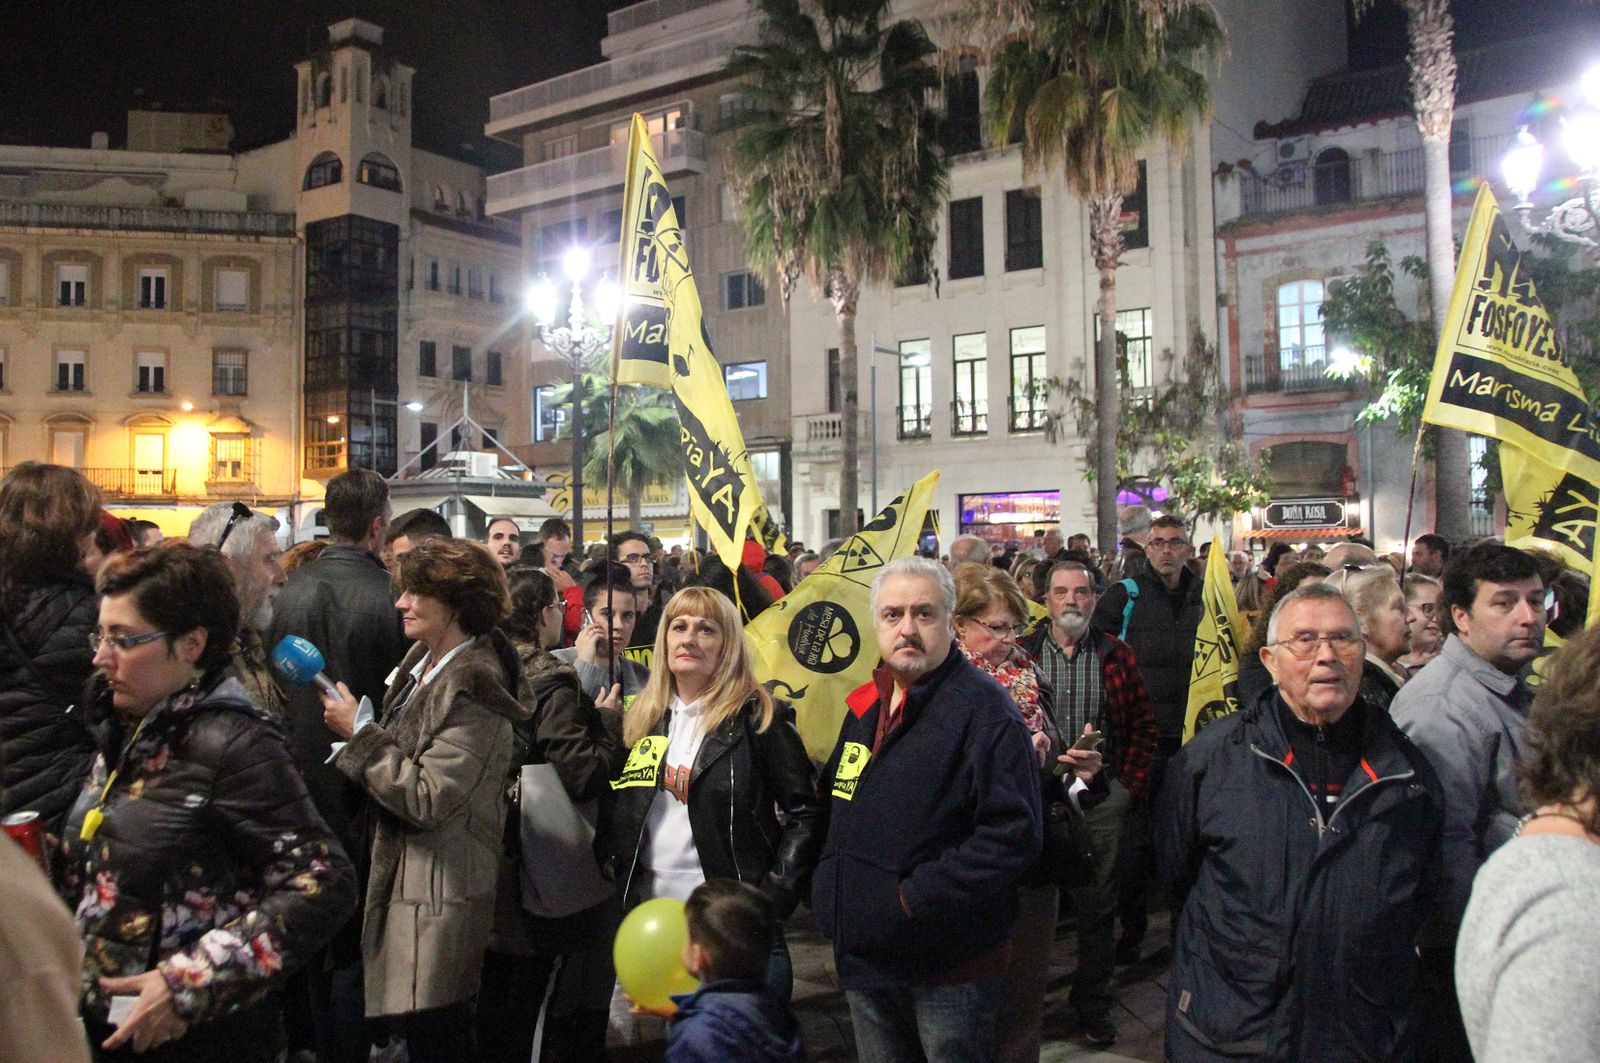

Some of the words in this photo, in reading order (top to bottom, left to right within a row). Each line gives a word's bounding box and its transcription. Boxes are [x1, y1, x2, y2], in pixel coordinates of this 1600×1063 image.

[1449, 368, 1562, 423] Marisma
[702, 451, 736, 524] YA
[1305, 504, 1327, 520] ROSA
